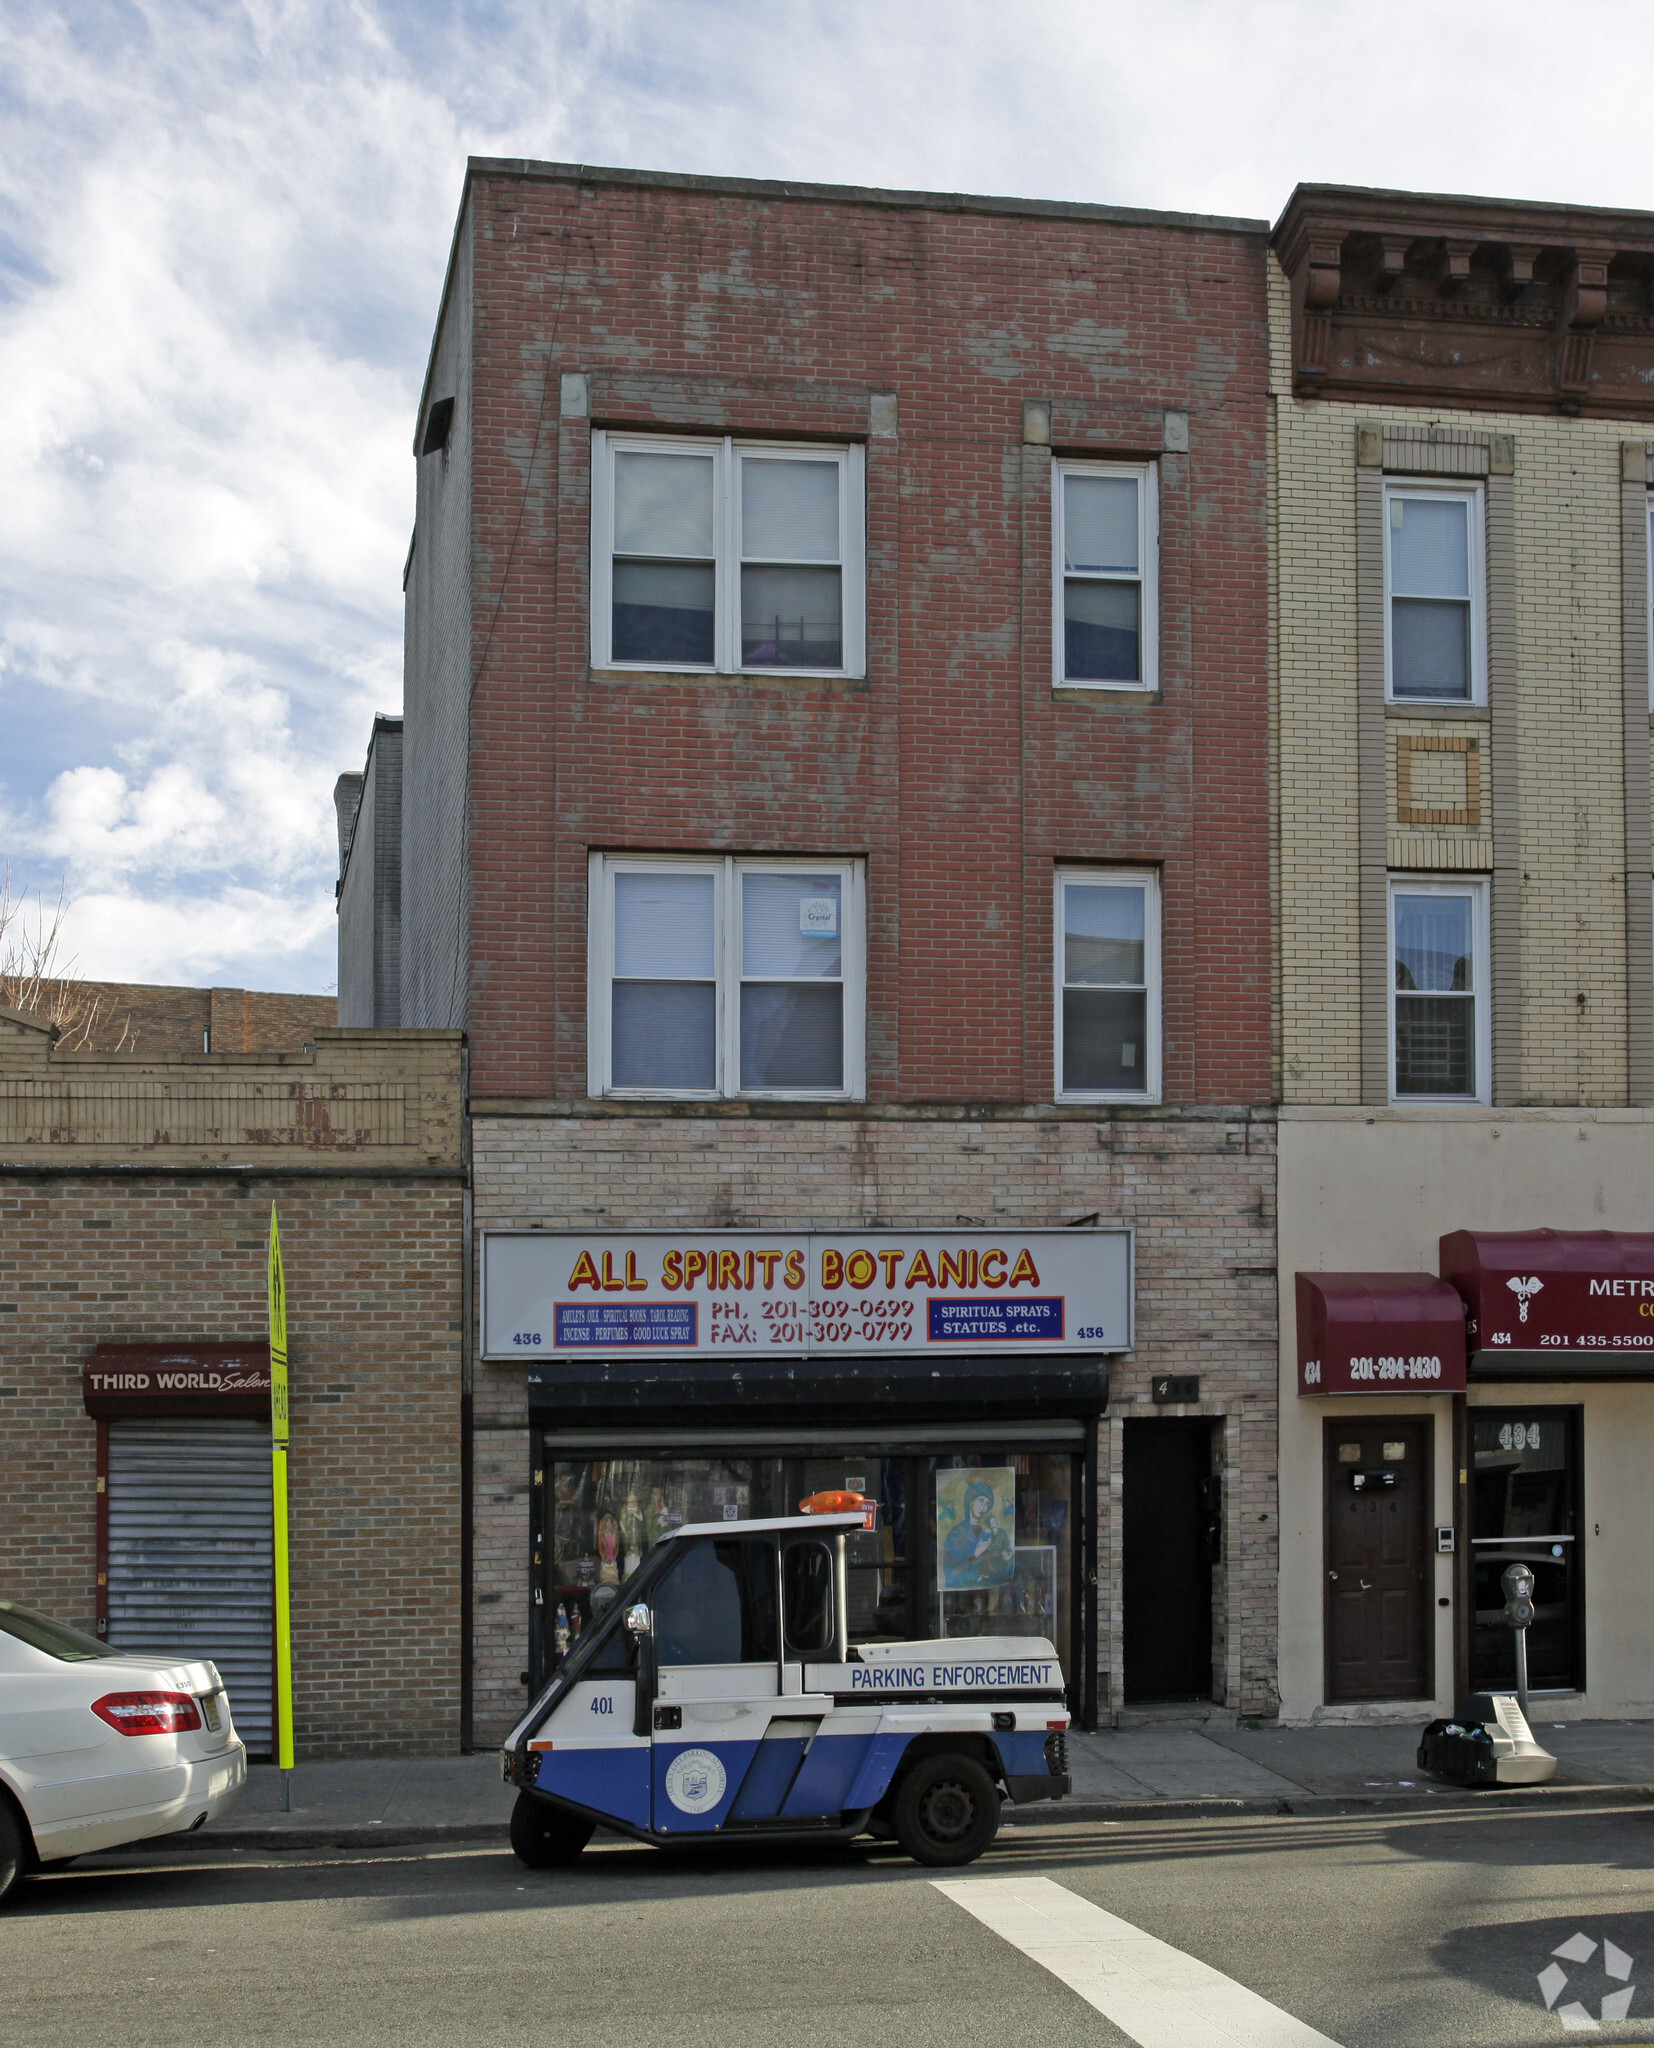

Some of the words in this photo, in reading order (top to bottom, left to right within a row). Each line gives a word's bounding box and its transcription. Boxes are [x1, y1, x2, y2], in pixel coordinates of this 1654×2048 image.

[568, 1250, 648, 1292] ALL
[661, 1249, 806, 1291] SPIRITS
[821, 1248, 1041, 1290] BOTANICA
[761, 1299, 914, 1319] 201-309-0699
[941, 1306, 1003, 1318] SPIRITUAL
[1006, 1305, 1051, 1317] SPRAYS
[563, 1327, 590, 1341] INCENSE
[595, 1327, 629, 1340] PERFUMES
[633, 1326, 651, 1340] GOOD
[652, 1326, 669, 1340] LUCK
[670, 1326, 690, 1340] SPRAY
[769, 1321, 913, 1343] 201-309-0799
[943, 1321, 1007, 1334] STATUES
[1077, 1326, 1104, 1339] 436
[512, 1332, 542, 1346] 436
[1491, 1332, 1512, 1344] 434
[1540, 1334, 1570, 1345] 201
[1576, 1335, 1654, 1346] 435-5500
[1304, 1360, 1321, 1384] 434
[1349, 1355, 1442, 1380] 201-294-1430
[90, 1373, 150, 1390] THIRD
[156, 1373, 222, 1389] WORLD
[218, 1371, 271, 1392] Salon
[1499, 1422, 1541, 1450] 434
[851, 1666, 925, 1688] PARKING
[933, 1665, 1052, 1686] ENFORCEMENT
[590, 1697, 614, 1715] 401
